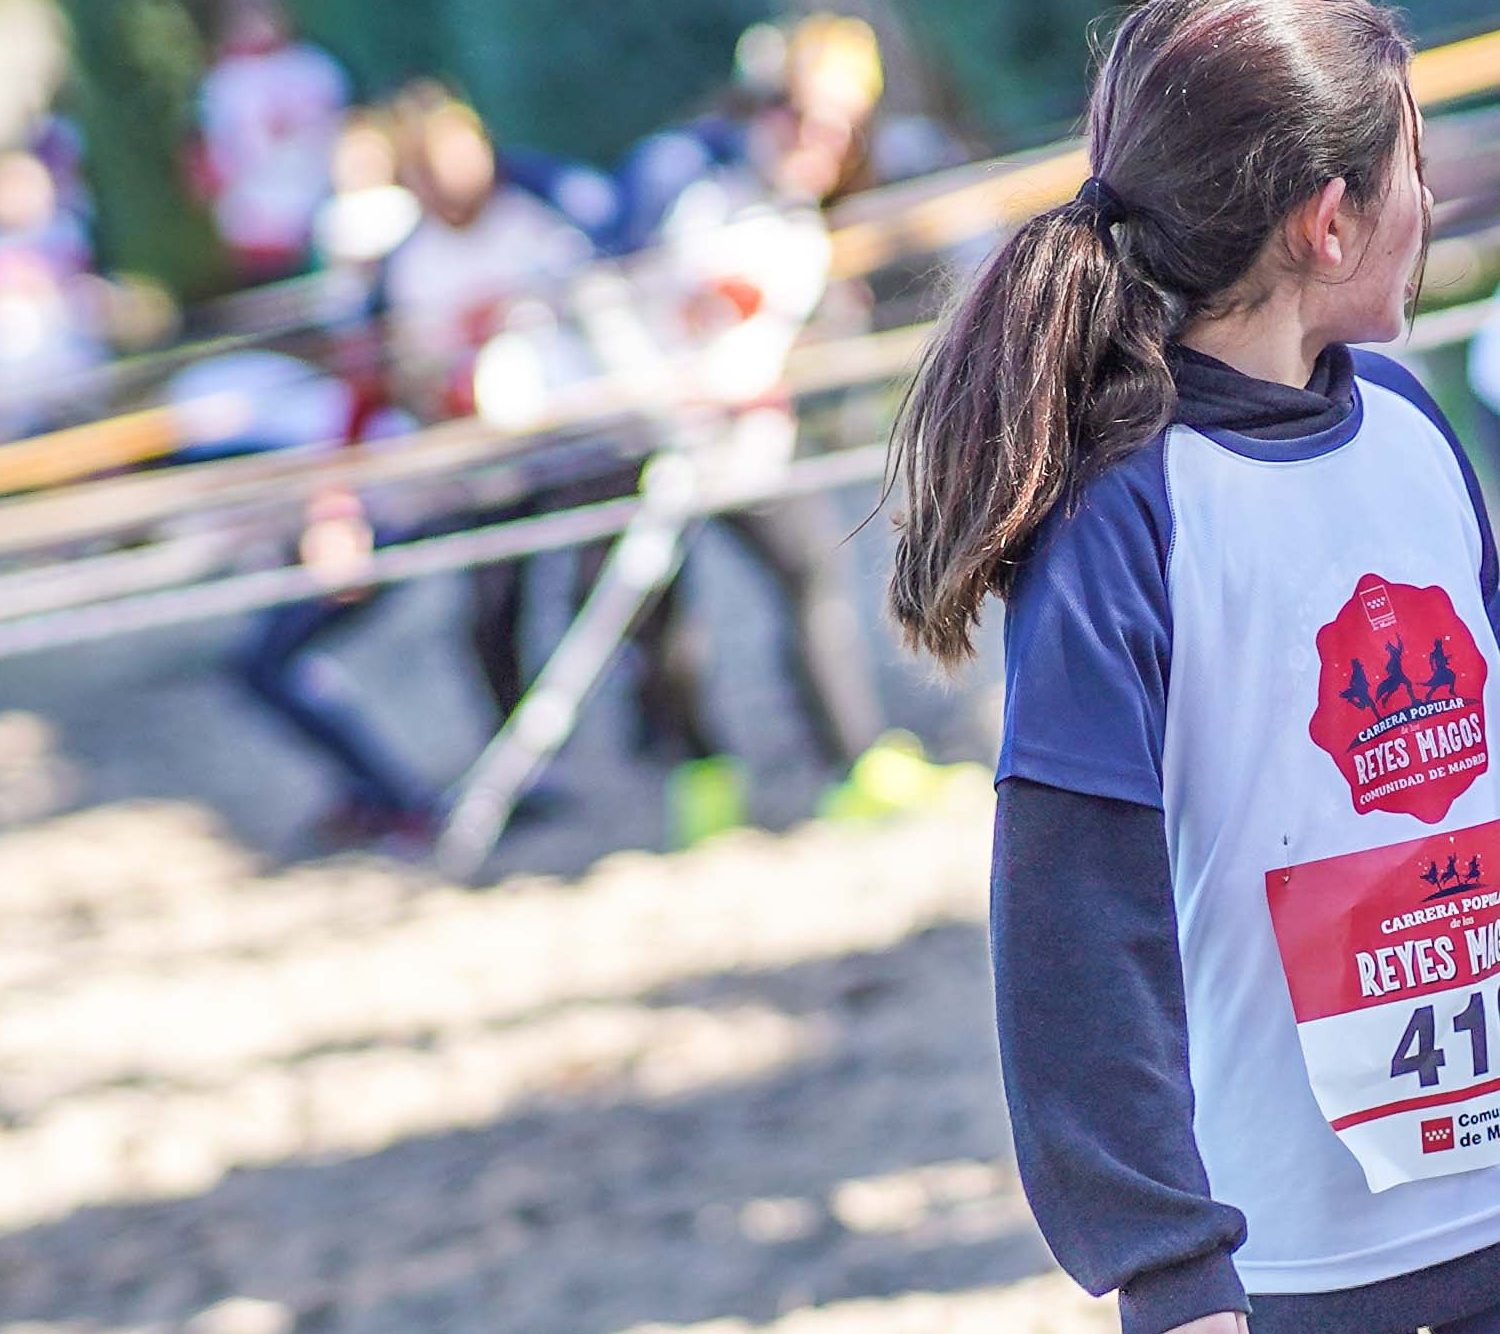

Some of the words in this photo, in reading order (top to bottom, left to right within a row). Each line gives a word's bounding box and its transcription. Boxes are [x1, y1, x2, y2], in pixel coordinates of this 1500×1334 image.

[1358, 712, 1407, 742] CARRERA
[1410, 697, 1465, 719] POPULAR
[1353, 738, 1410, 785] REYES
[1415, 713, 1482, 763] MAGOS
[1360, 773, 1425, 805] COMUNIDAD
[1428, 766, 1447, 780] DE
[1447, 753, 1487, 774] MADRID
[1381, 902, 1460, 934] CARRERA
[1450, 918, 1461, 929] de
[1462, 915, 1475, 927] los
[1355, 936, 1457, 997] REYES
[1459, 1132, 1482, 1148] de
